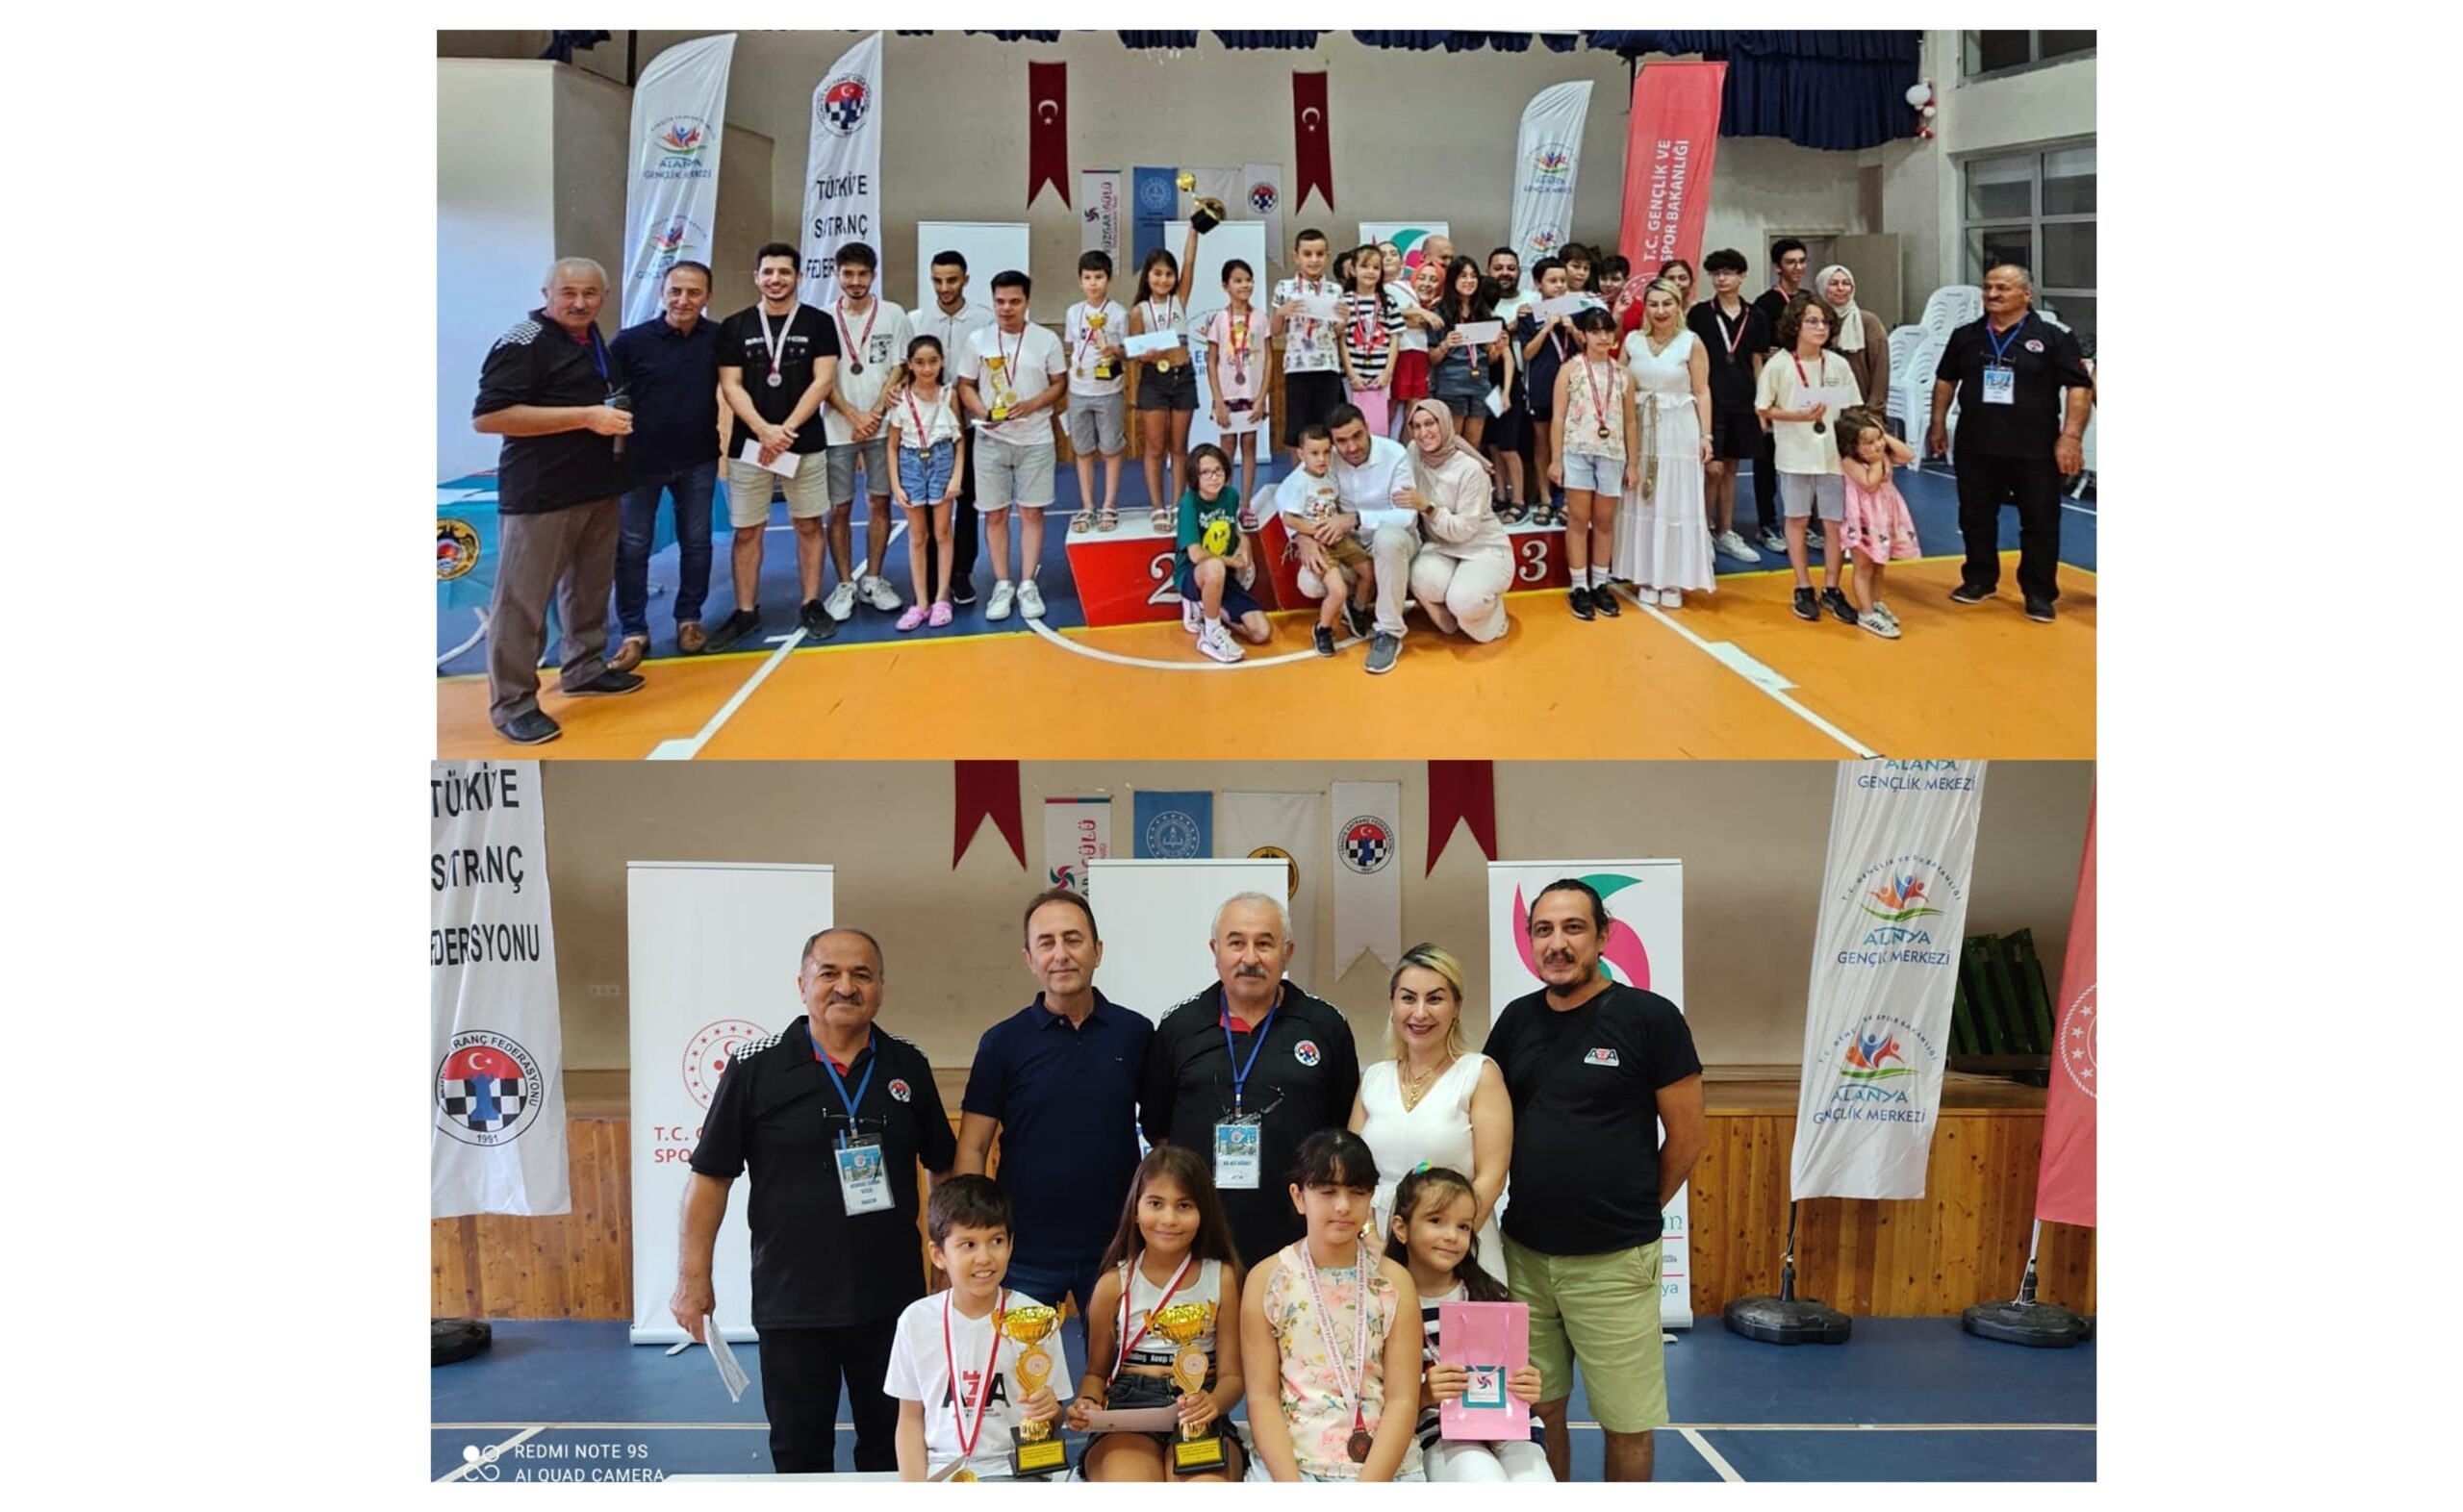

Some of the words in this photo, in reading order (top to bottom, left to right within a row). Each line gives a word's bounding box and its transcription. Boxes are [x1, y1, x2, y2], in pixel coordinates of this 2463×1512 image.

[1656, 139, 1672, 160] VE
[1665, 139, 1690, 220] BAKANLIĞI
[1647, 164, 1669, 231] GENÇLİK
[1519, 540, 1548, 582] 3
[1148, 552, 1182, 605] 2
[1858, 774, 1920, 793] GENÇLİK
[1891, 949, 1951, 966] MERKEZİ
[491, 1037, 541, 1107] FEDERASYONU
[1831, 1084, 1909, 1103] ALANYA
[1866, 1108, 1927, 1123] MERKEZİ
[477, 1134, 499, 1144] 1991
[653, 1126, 689, 1142] T.C.
[654, 1147, 693, 1163] SPO
